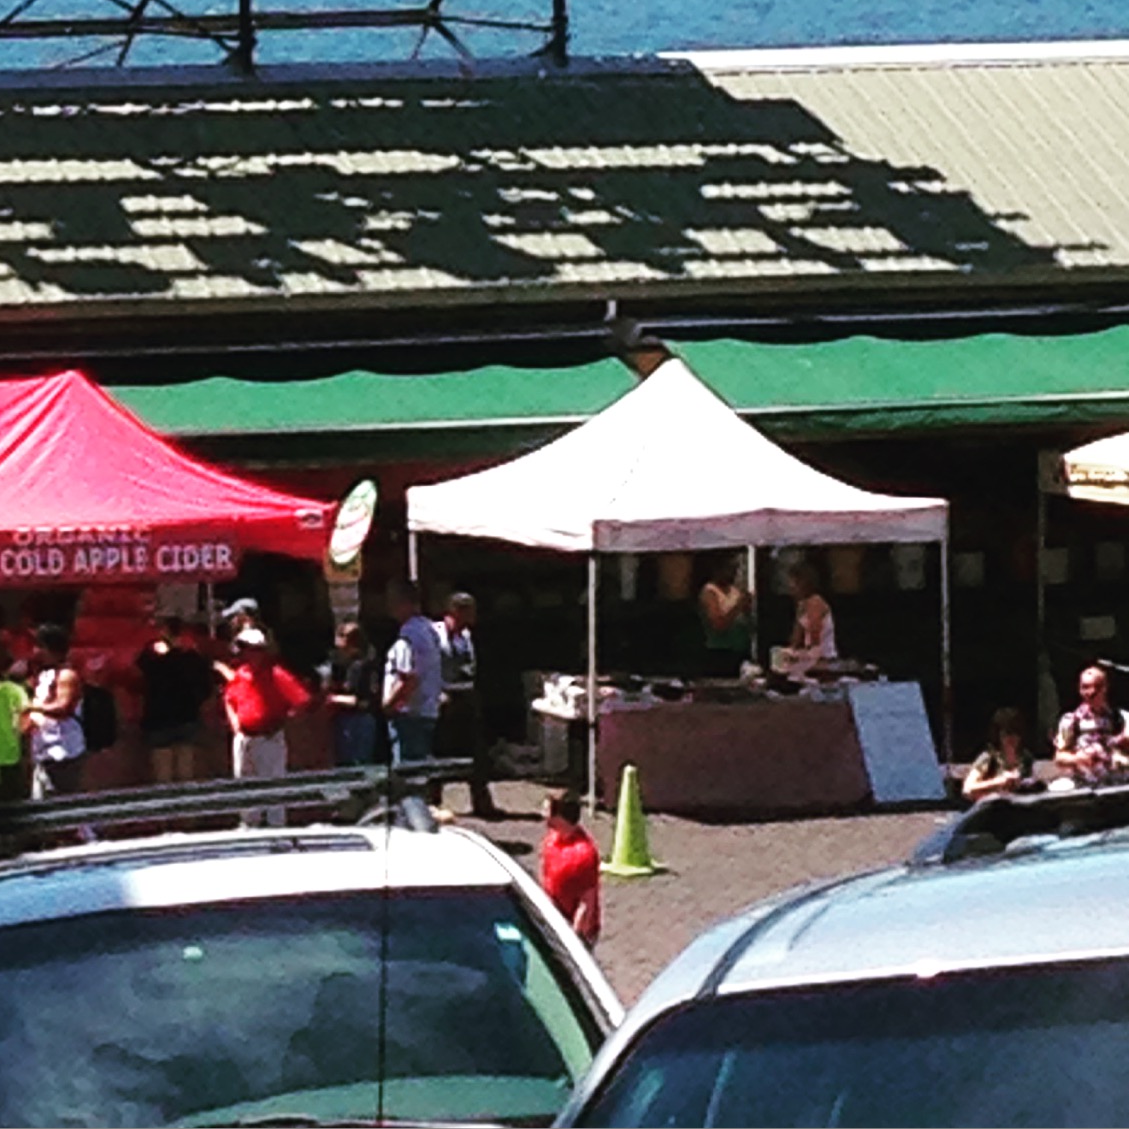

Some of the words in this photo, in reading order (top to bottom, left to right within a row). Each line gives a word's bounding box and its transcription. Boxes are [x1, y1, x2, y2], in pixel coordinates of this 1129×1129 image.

[0, 547, 65, 577] COLD
[73, 545, 149, 574] APPLE
[155, 543, 234, 572] CIDER
